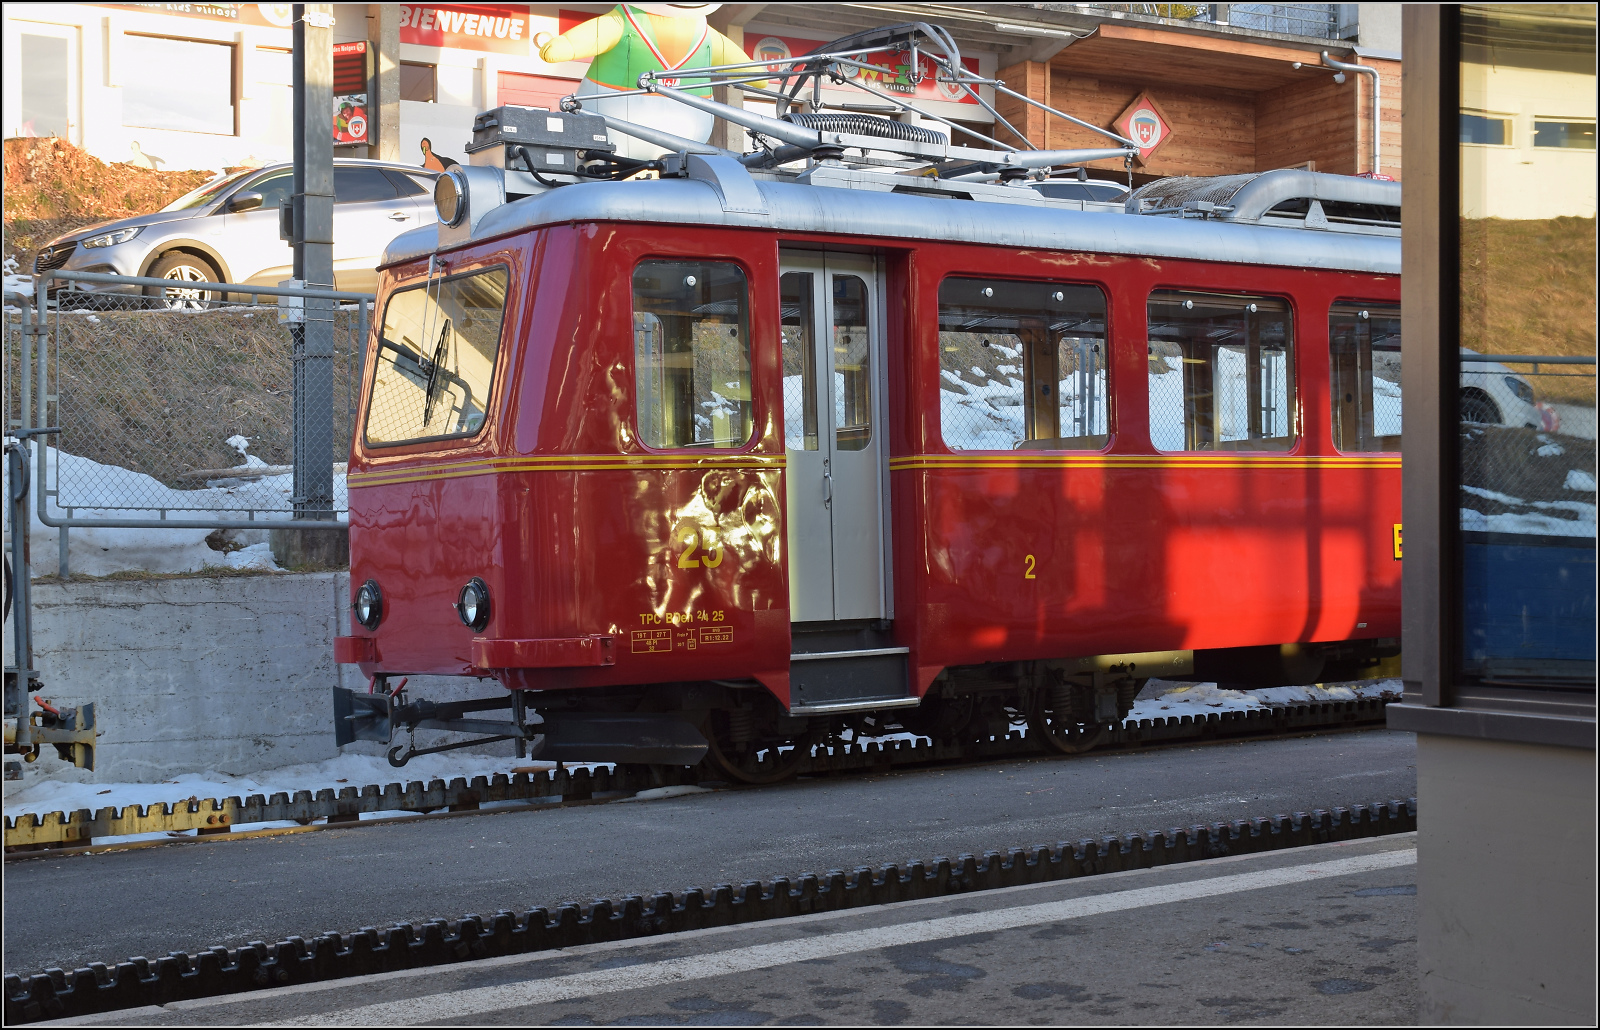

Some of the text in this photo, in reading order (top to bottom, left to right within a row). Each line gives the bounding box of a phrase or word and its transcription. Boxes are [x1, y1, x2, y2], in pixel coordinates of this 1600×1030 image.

[196, 6, 237, 18] village
[400, 5, 524, 40] BIENVENUE
[885, 83, 915, 93] village
[677, 526, 724, 569] 25
[1025, 554, 1036, 579] 2
[640, 613, 662, 625] TPC
[712, 610, 725, 622] 25
